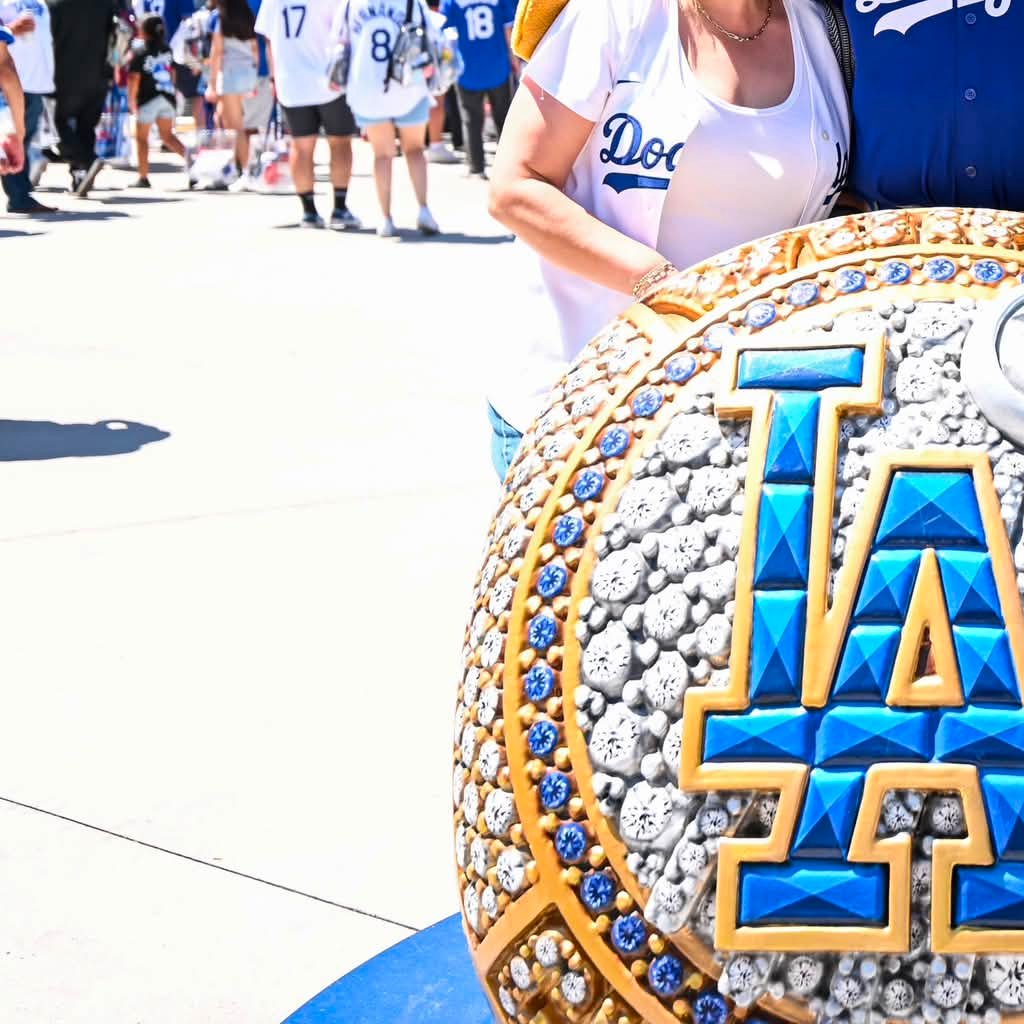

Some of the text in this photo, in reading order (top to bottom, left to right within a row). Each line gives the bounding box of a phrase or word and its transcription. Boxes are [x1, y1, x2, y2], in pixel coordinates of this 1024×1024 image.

[282, 5, 306, 39] 17
[464, 5, 495, 41] 18
[371, 29, 391, 63] 8
